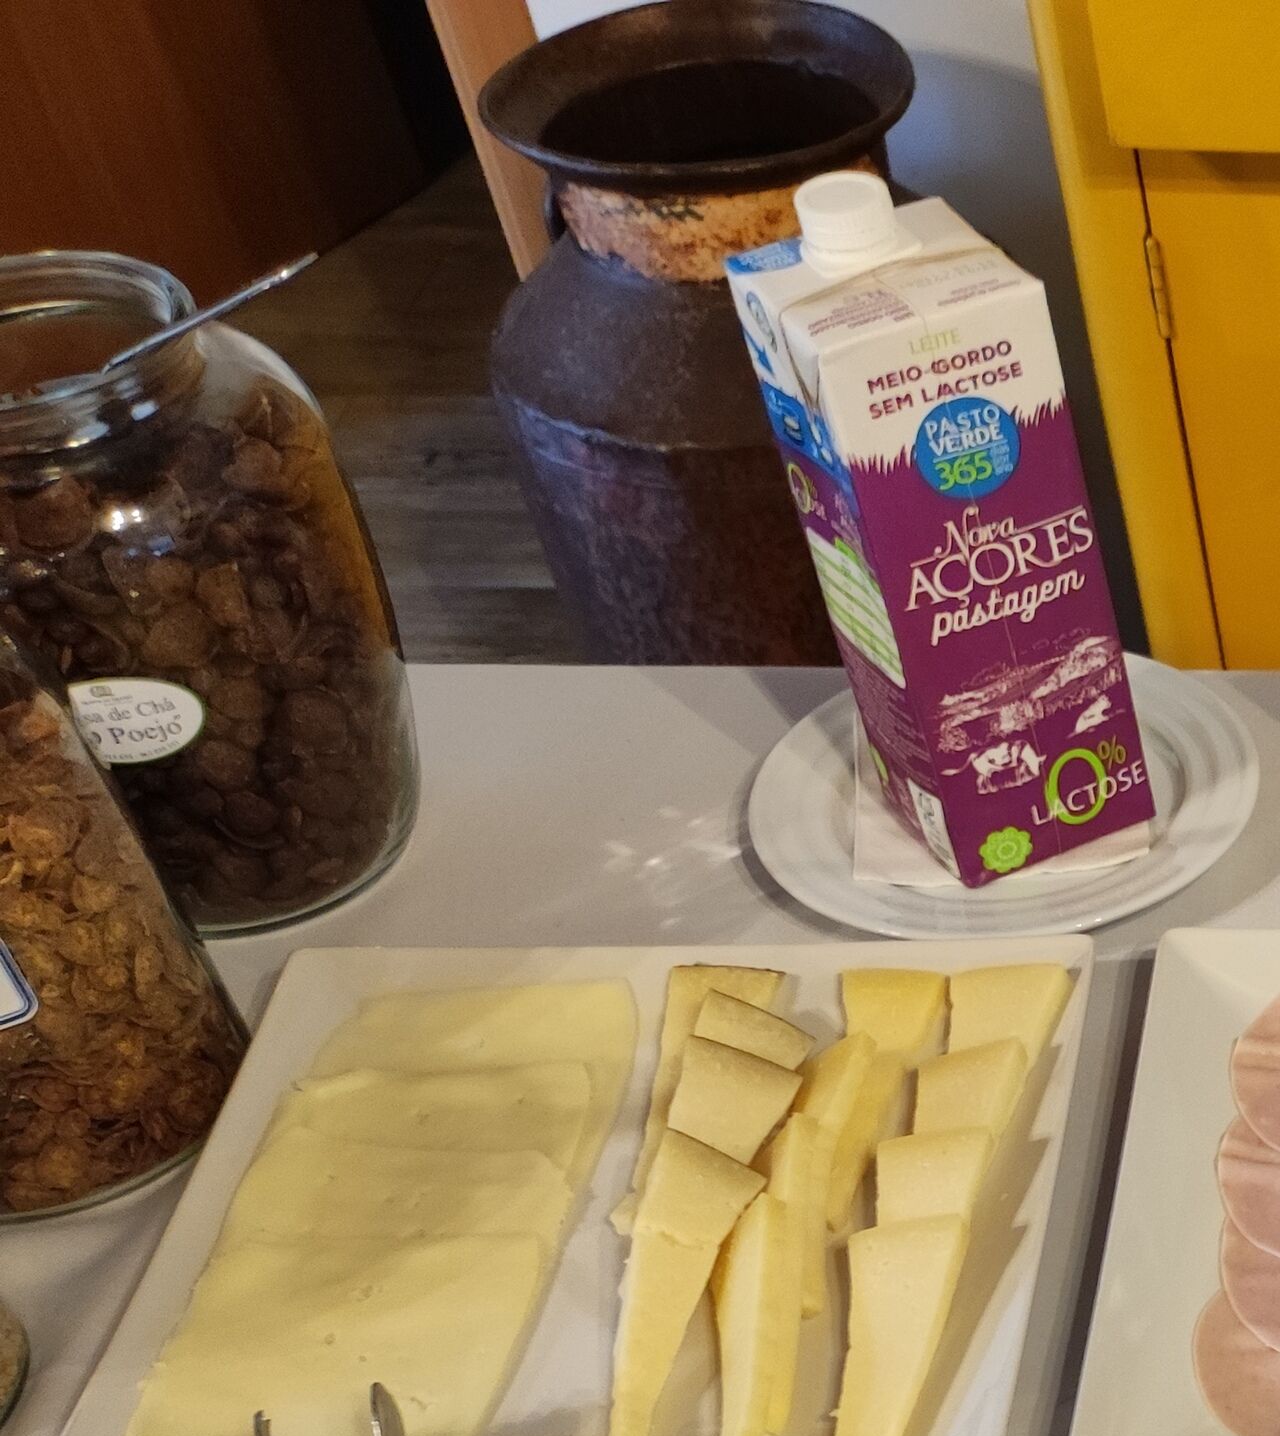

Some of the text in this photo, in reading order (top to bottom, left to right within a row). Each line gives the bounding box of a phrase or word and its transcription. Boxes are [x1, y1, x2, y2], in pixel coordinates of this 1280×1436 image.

[909, 329, 960, 354] LEITE
[869, 361, 1023, 419] SEM LACTOSE
[925, 404, 1000, 441] PASTO
[929, 423, 1004, 456] VERDE
[935, 451, 993, 490] 365
[934, 506, 1017, 559] Nova
[905, 508, 1095, 612] AÇORES
[930, 567, 1086, 647] pastagem
[108, 707, 132, 721] de
[1031, 760, 1146, 825] LACTOSE
